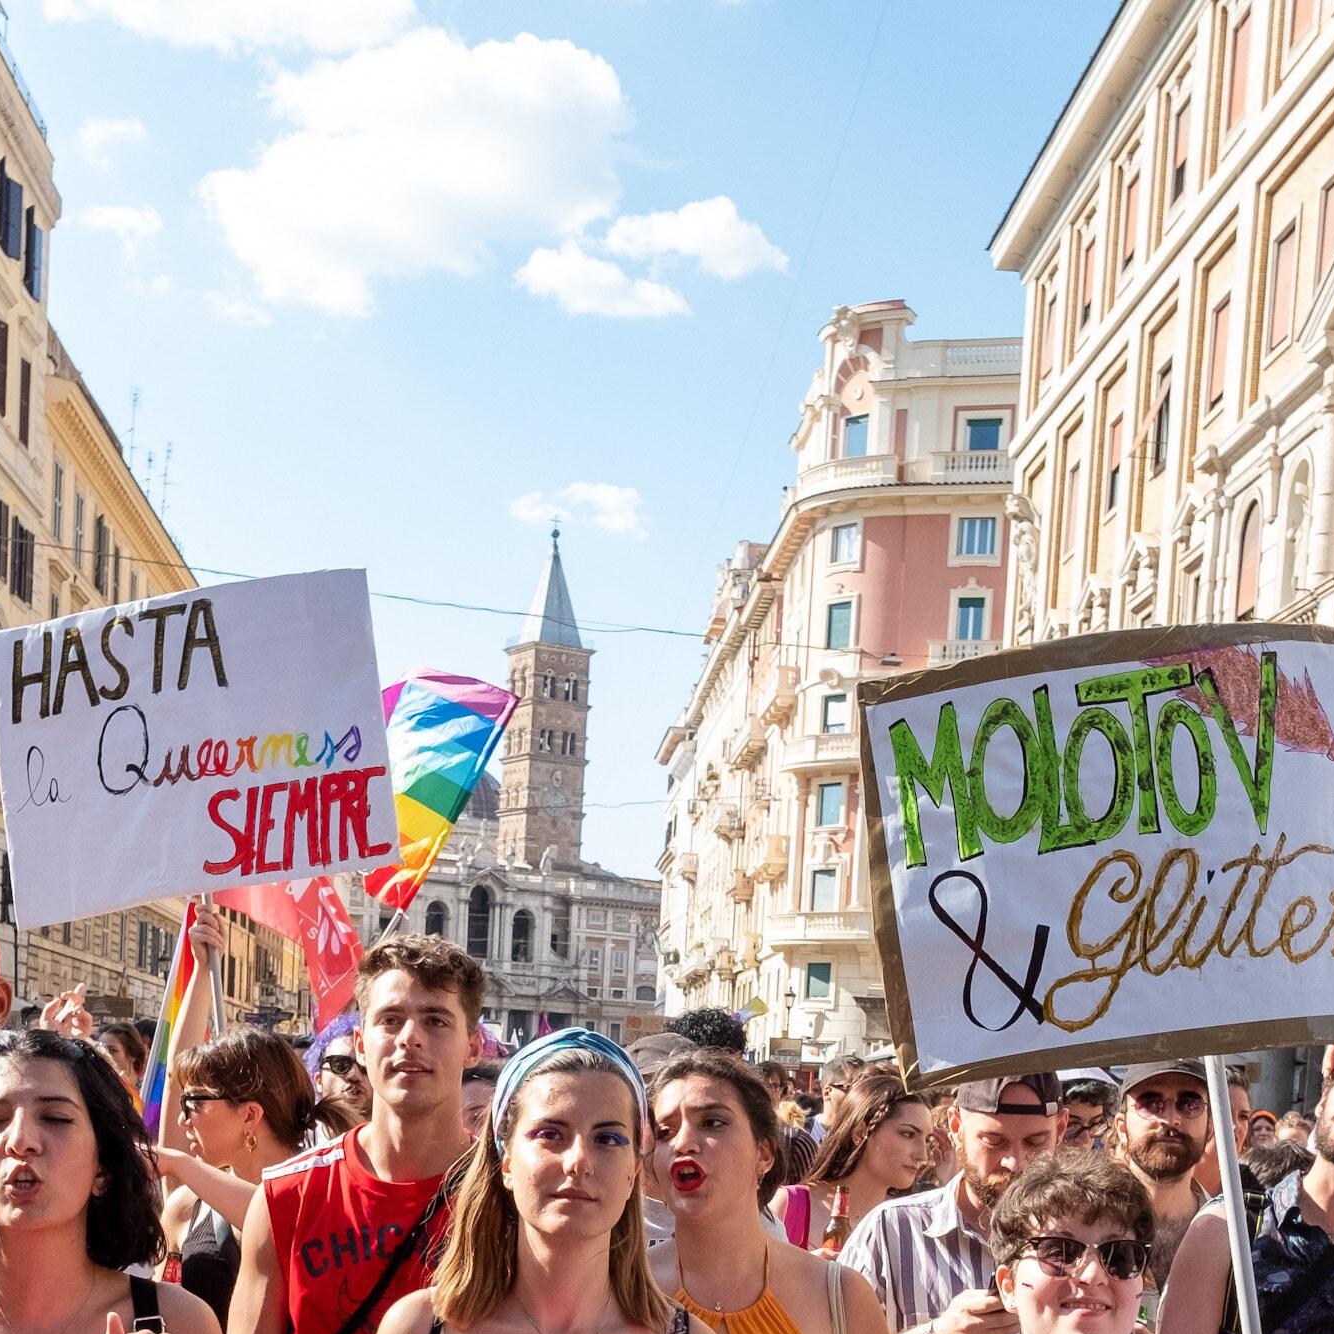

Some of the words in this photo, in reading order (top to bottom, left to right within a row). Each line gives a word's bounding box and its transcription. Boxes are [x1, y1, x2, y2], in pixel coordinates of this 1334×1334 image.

[11, 598, 229, 725] HASTA
[17, 745, 71, 813] la
[97, 703, 362, 795] Queerness
[202, 765, 392, 877] SIEMPRE
[889, 651, 1277, 869] MOLOTOV
[928, 870, 1050, 1032] &
